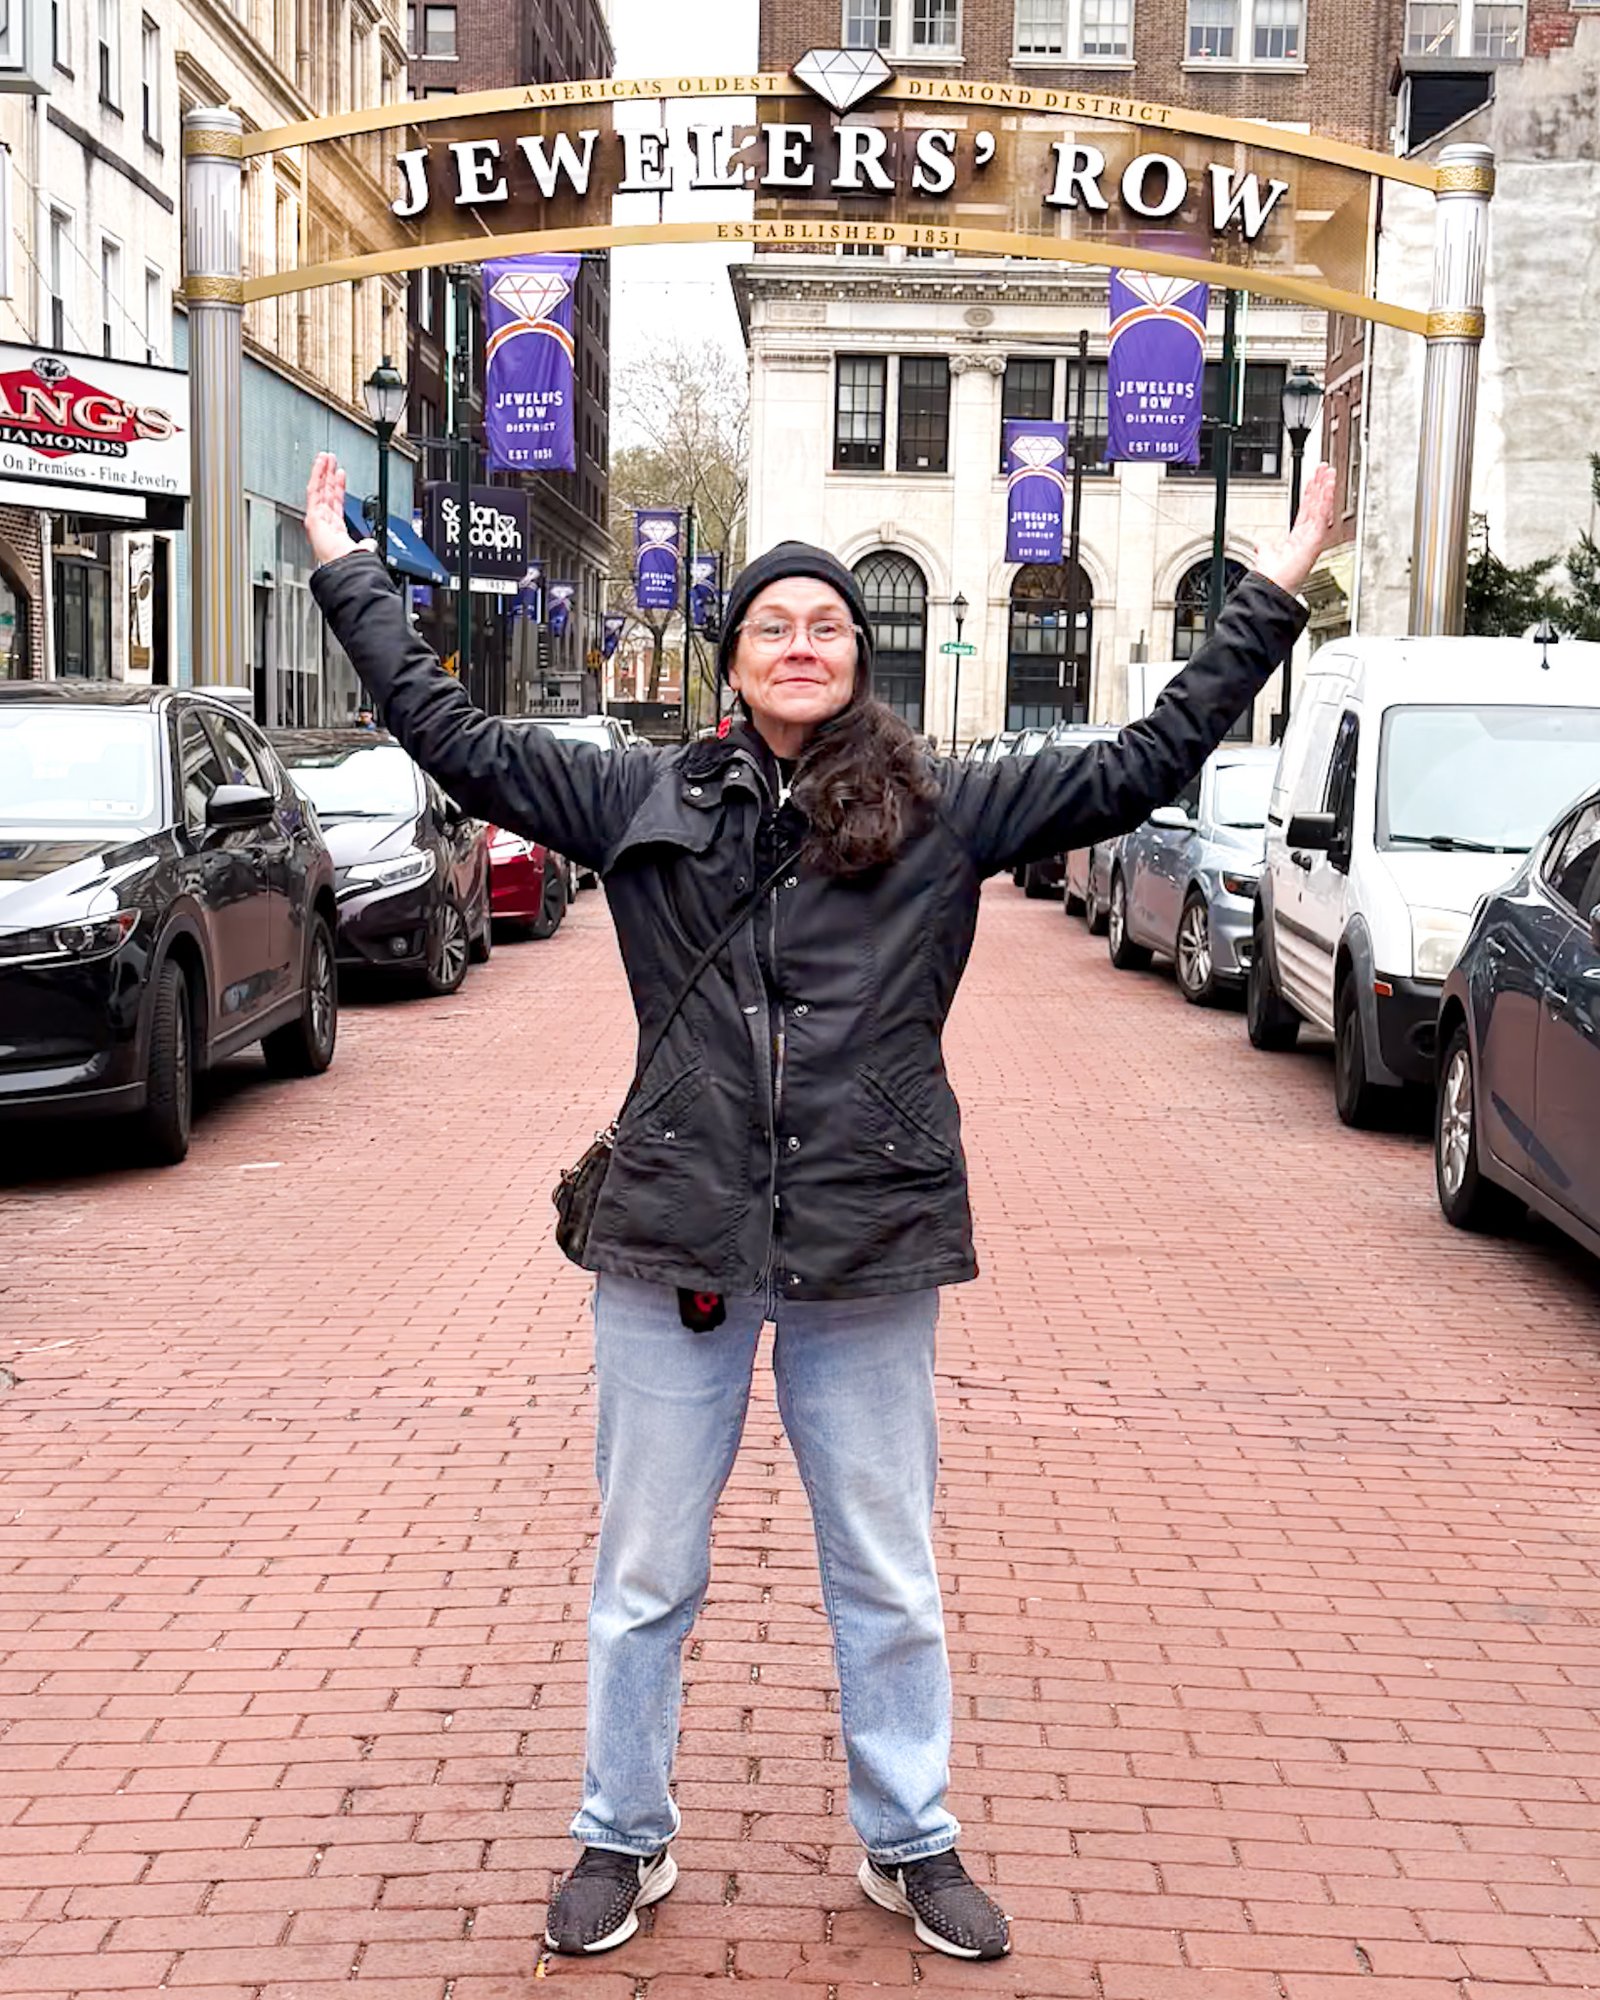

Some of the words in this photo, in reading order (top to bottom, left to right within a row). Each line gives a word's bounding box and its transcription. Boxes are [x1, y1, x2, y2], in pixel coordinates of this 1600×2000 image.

[523, 80, 662, 104] AMERICA'S
[678, 76, 778, 93] OLDEST
[909, 81, 1031, 104] DIAMOND
[1045, 93, 1172, 123] DISTRICT
[1045, 141, 1289, 238] ROW
[717, 224, 895, 241] ESTABLISHED
[913, 229, 961, 245] 1851
[1115, 381, 1194, 399] JEWELERS
[1139, 396, 1172, 409] ROW
[518, 406, 547, 419] ROW
[1125, 413, 1186, 424] DISTRICT
[506, 422, 556, 433] DISTRICT
[0, 427, 125, 457] IAMONDS
[1128, 441, 1150, 453] EST
[508, 449, 528, 460] EST
[3, 454, 24, 469] On
[28, 458, 86, 477] Premises
[99, 466, 127, 484] Fine
[130, 470, 178, 492] Jewelry
[446, 521, 522, 553] Rdolph
